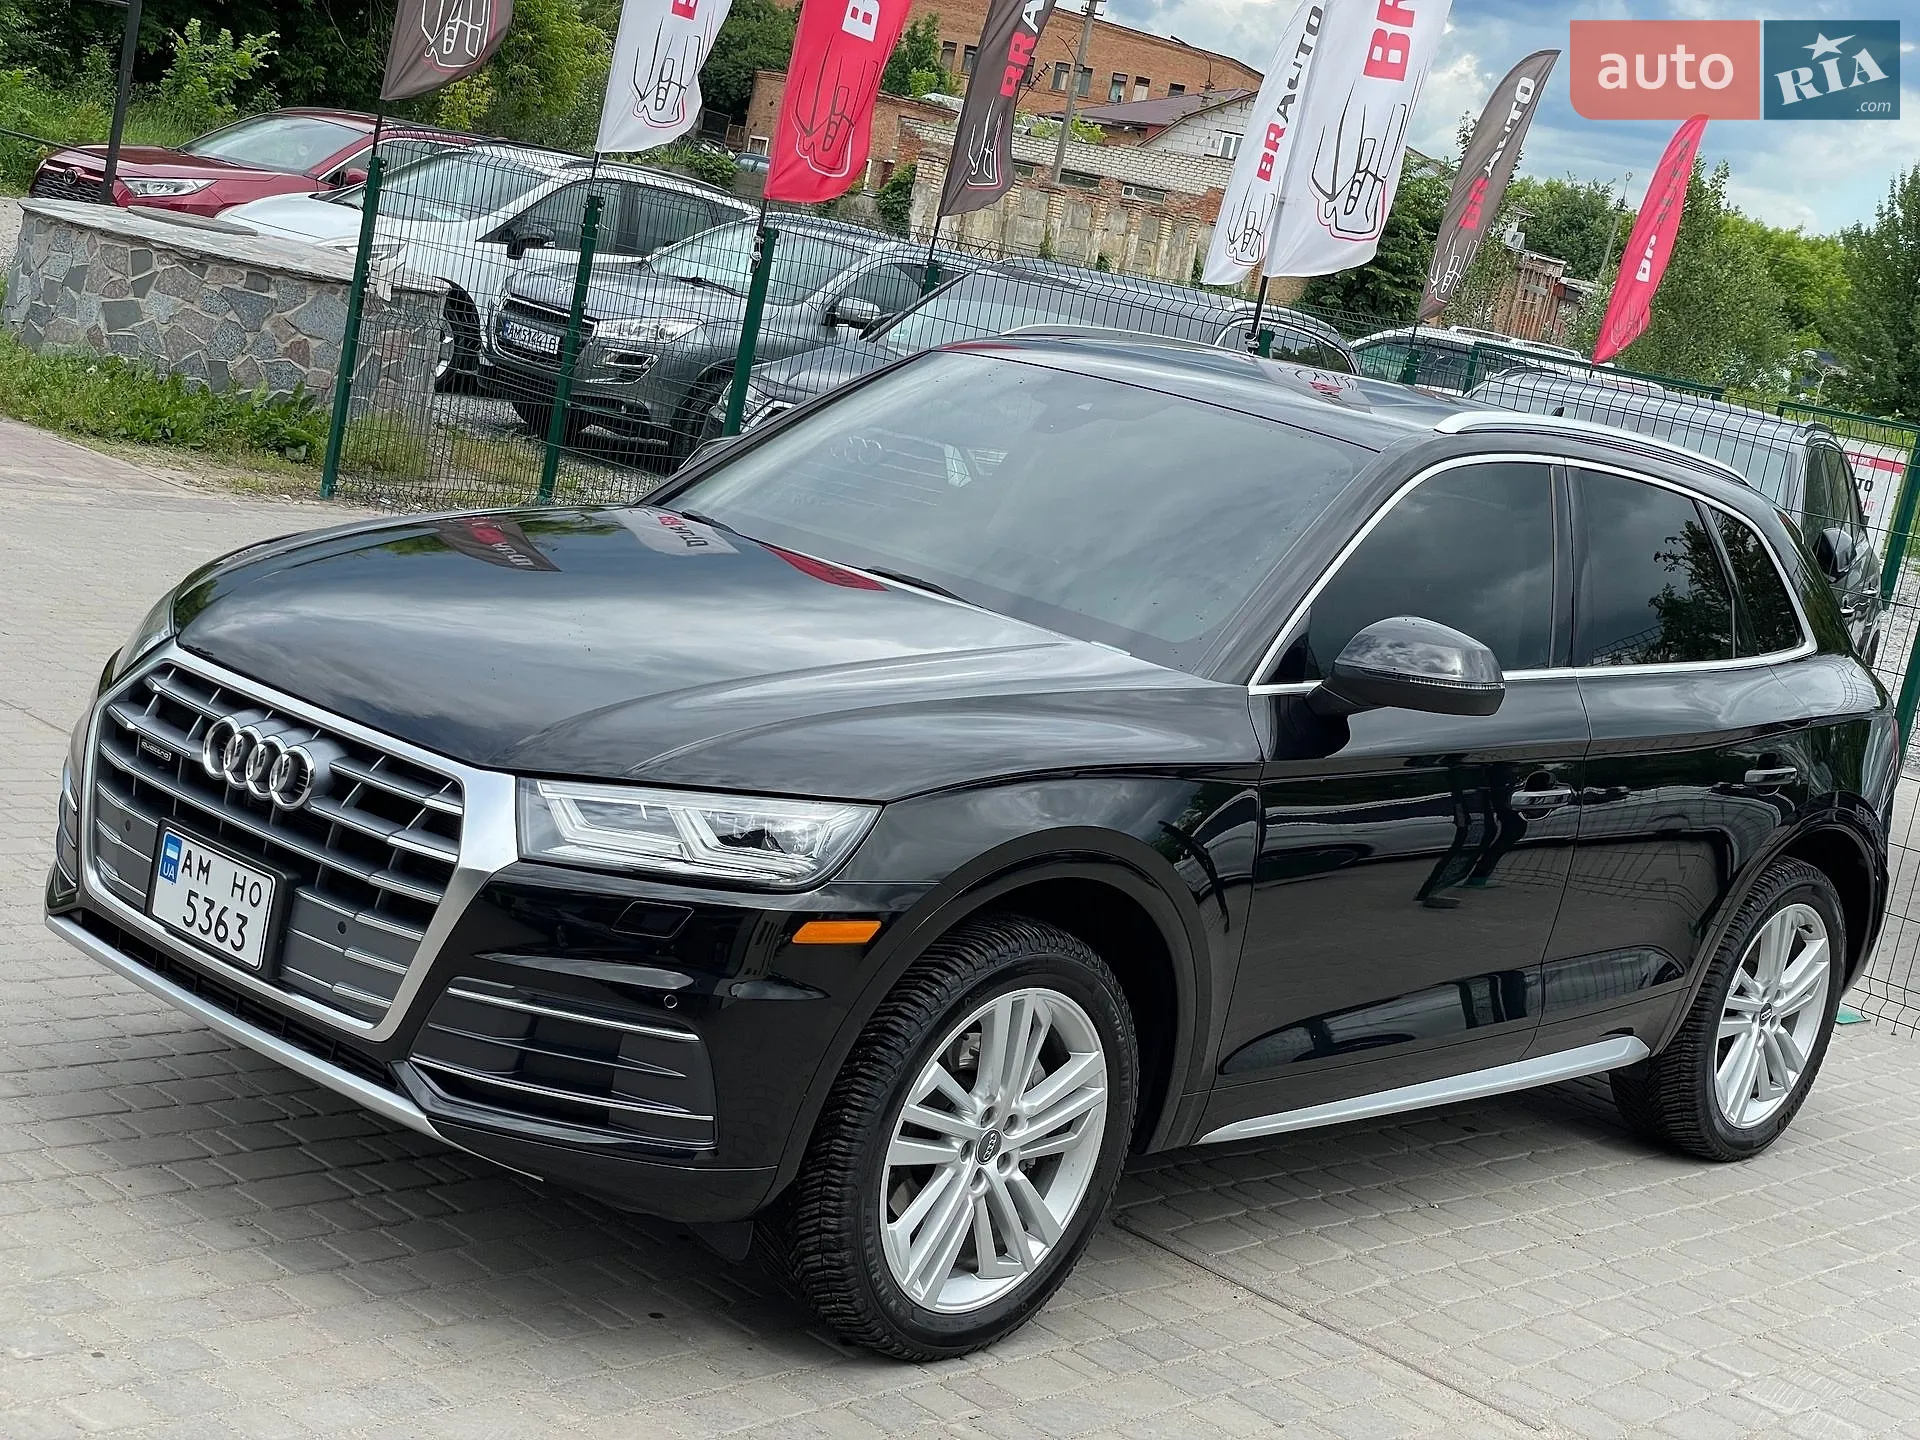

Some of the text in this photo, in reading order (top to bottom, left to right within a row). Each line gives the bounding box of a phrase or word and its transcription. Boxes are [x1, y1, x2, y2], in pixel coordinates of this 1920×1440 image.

[1257, 6, 1323, 182] BRAUTO
[162, 862, 176, 880] UA
[181, 849, 262, 908] AM HO
[182, 889, 248, 952] 5363
